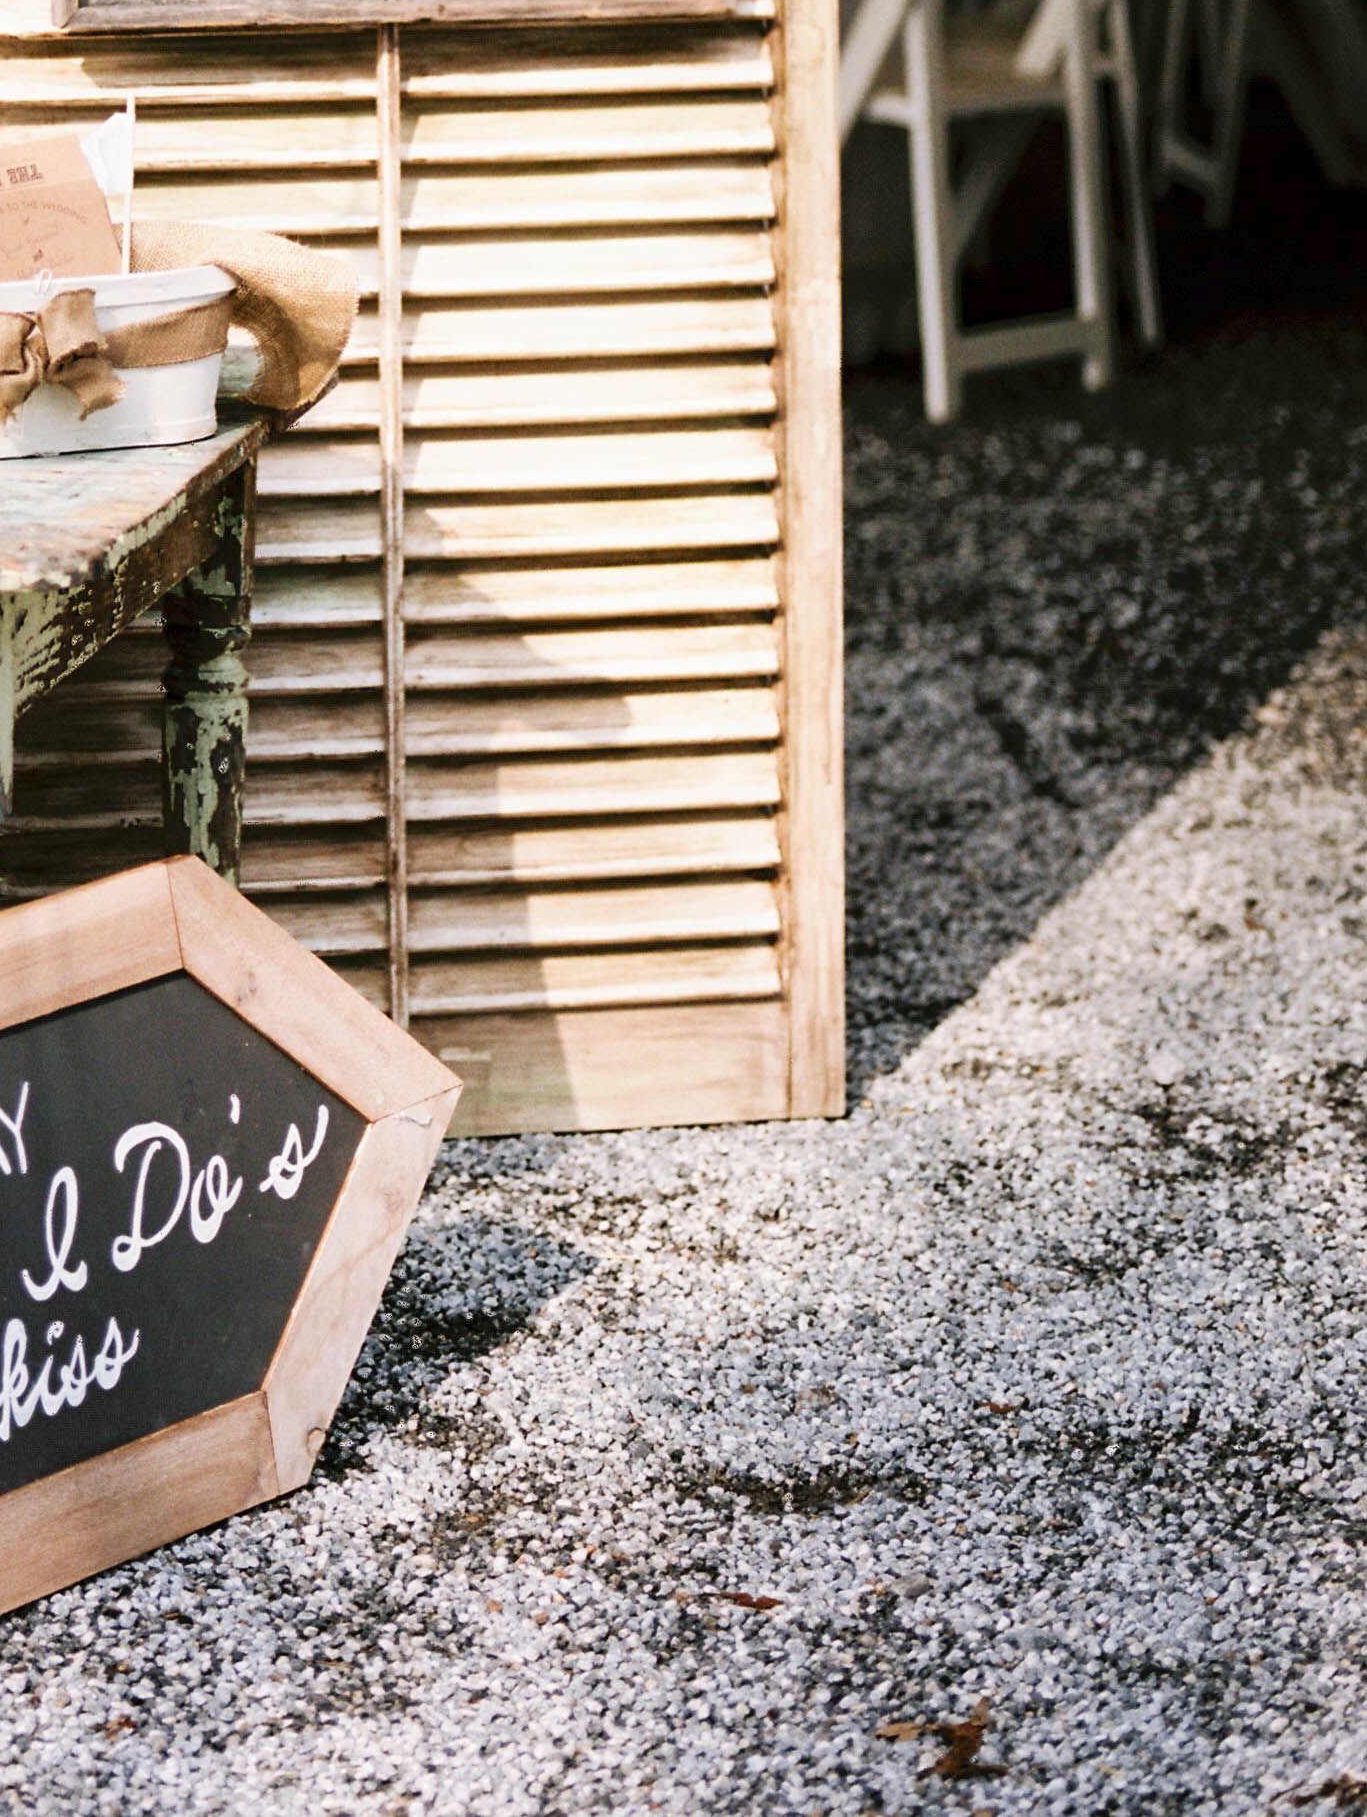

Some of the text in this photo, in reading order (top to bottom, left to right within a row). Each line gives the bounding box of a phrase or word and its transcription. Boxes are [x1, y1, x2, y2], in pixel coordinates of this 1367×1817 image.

[6, 163, 44, 184] THE
[6, 202, 19, 212] TO
[21, 200, 38, 210] THE
[42, 201, 89, 225] WEDDING
[22, 1165, 88, 1302] I
[111, 1093, 330, 1273] Do's
